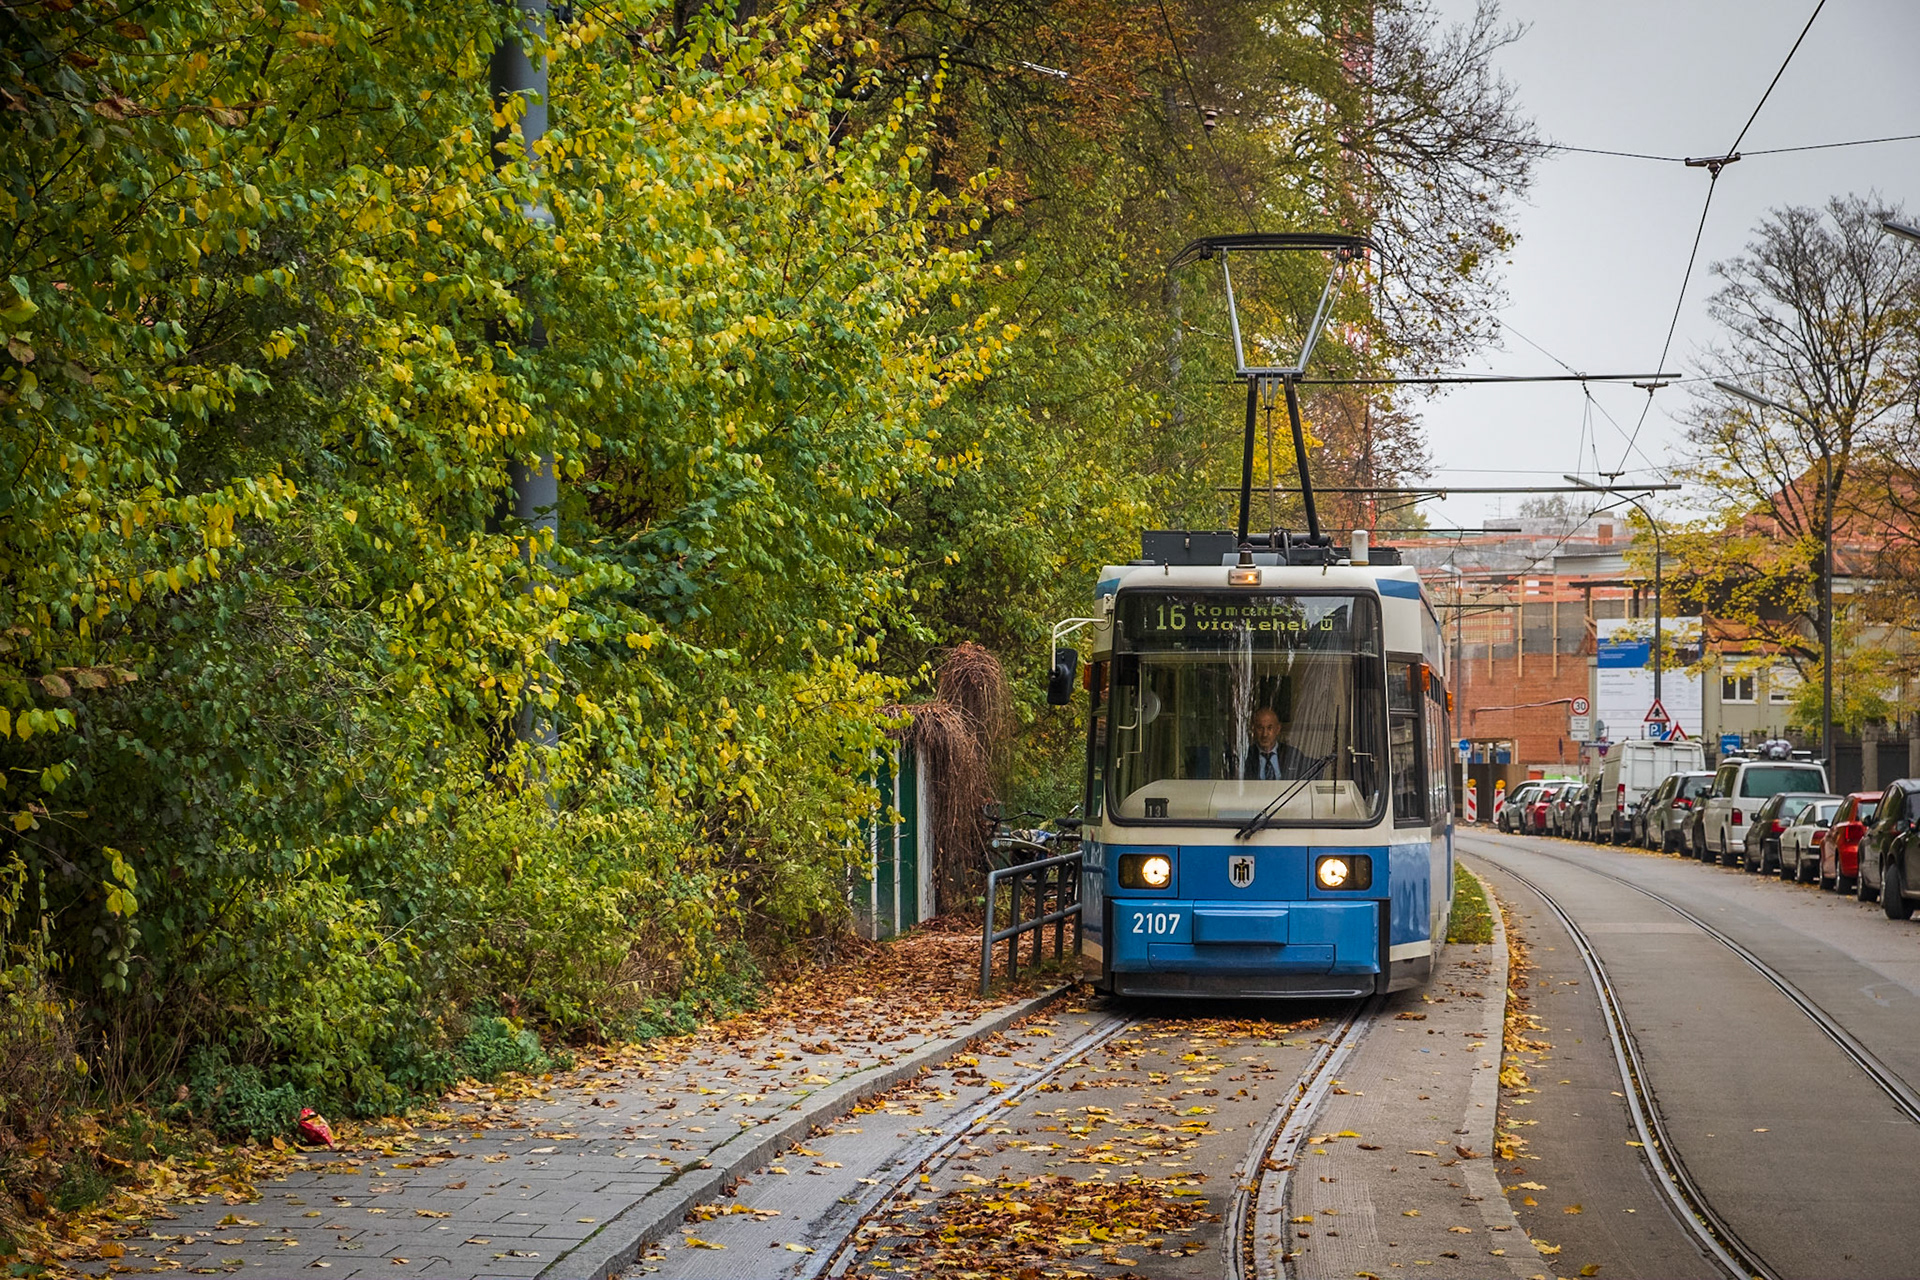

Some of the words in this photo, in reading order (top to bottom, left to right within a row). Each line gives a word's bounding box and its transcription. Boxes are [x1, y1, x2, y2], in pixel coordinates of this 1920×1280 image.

[1156, 604, 1186, 630] 16
[1197, 618, 1233, 630] via
[1245, 618, 1308, 630] Lehel
[1575, 701, 1586, 711] 30
[1650, 724, 1658, 736] P
[1132, 912, 1181, 935] 2107
